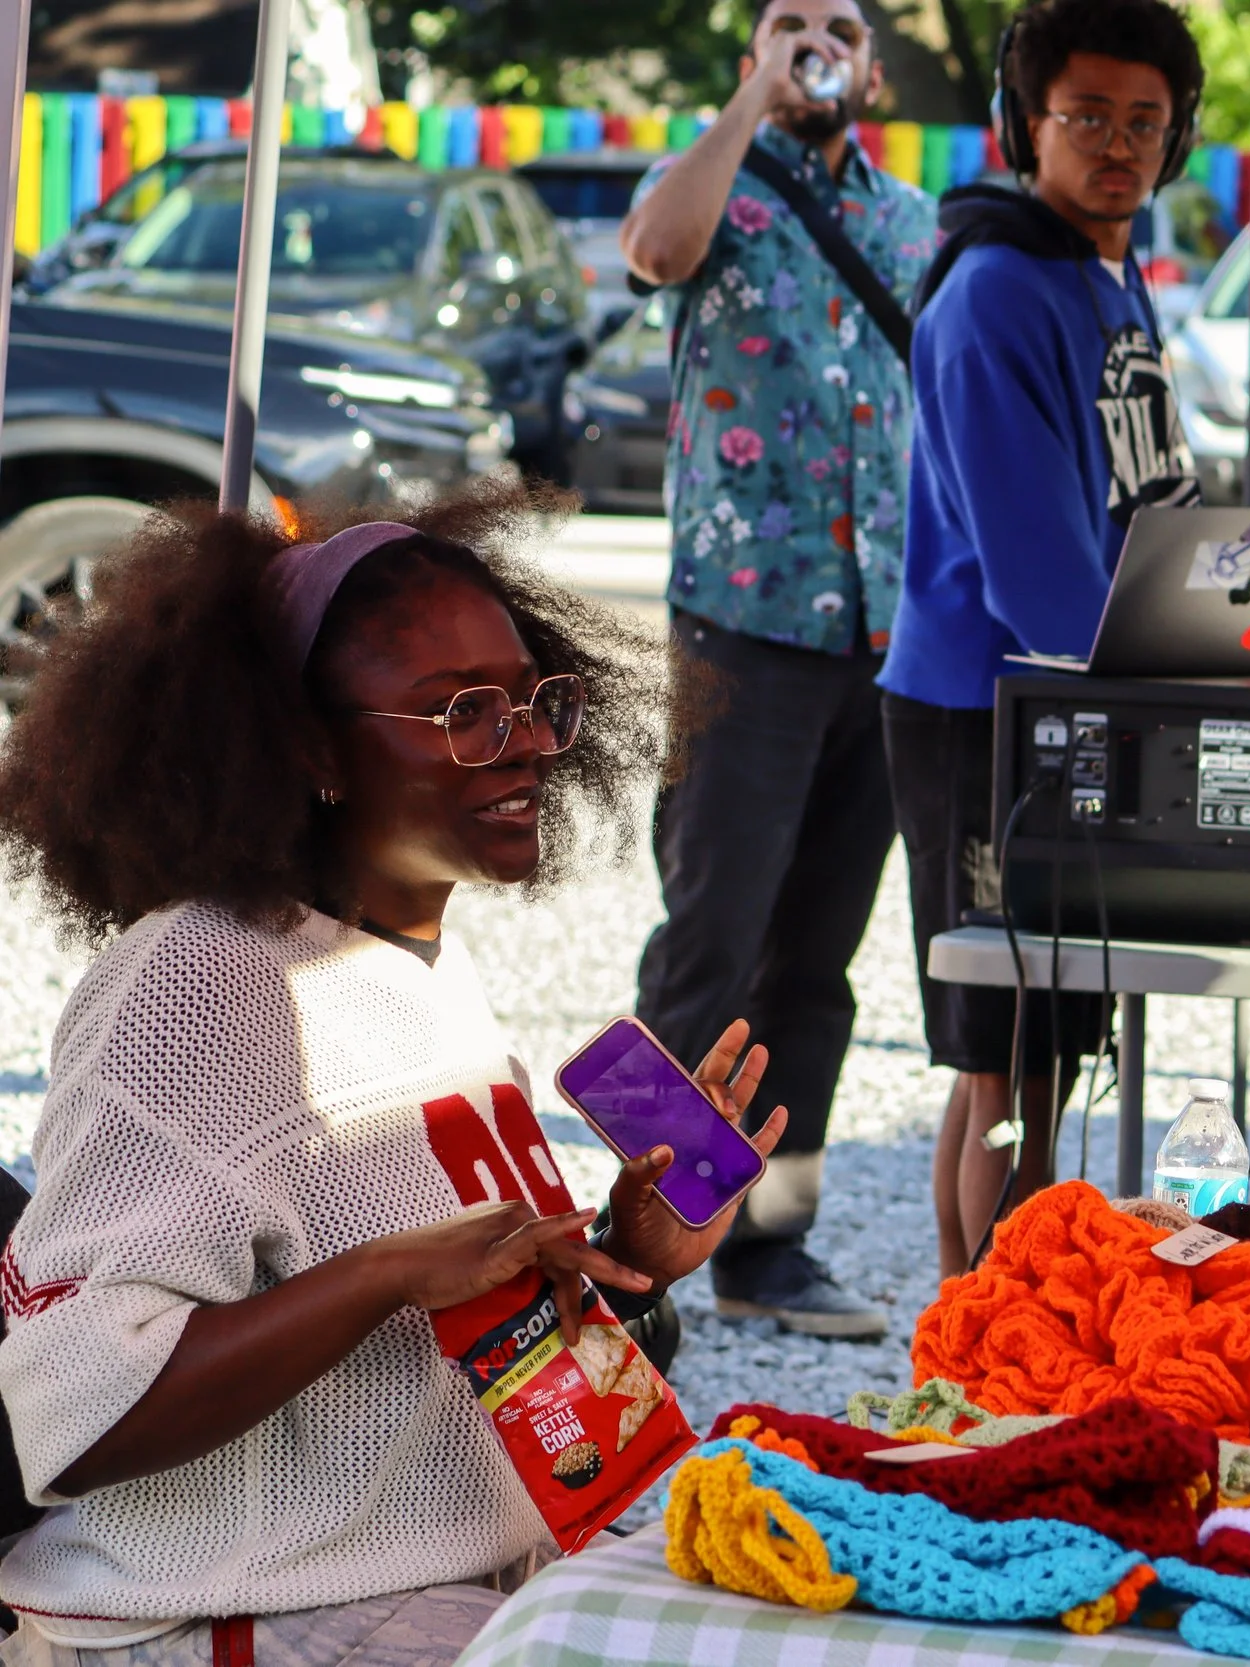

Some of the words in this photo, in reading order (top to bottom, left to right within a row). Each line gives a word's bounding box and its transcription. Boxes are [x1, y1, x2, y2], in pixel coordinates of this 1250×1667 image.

[515, 1360, 536, 1379] NEVER
[534, 1343, 552, 1365] FRIED
[527, 1389, 557, 1408] ARTIFICIAL
[533, 1389, 543, 1397] NO
[498, 1407, 523, 1422] ARTIFICIAL
[528, 1409, 547, 1425] SWEET
[552, 1397, 569, 1411] SALTY
[533, 1405, 577, 1438] KETTLE
[541, 1418, 586, 1455] CORN
